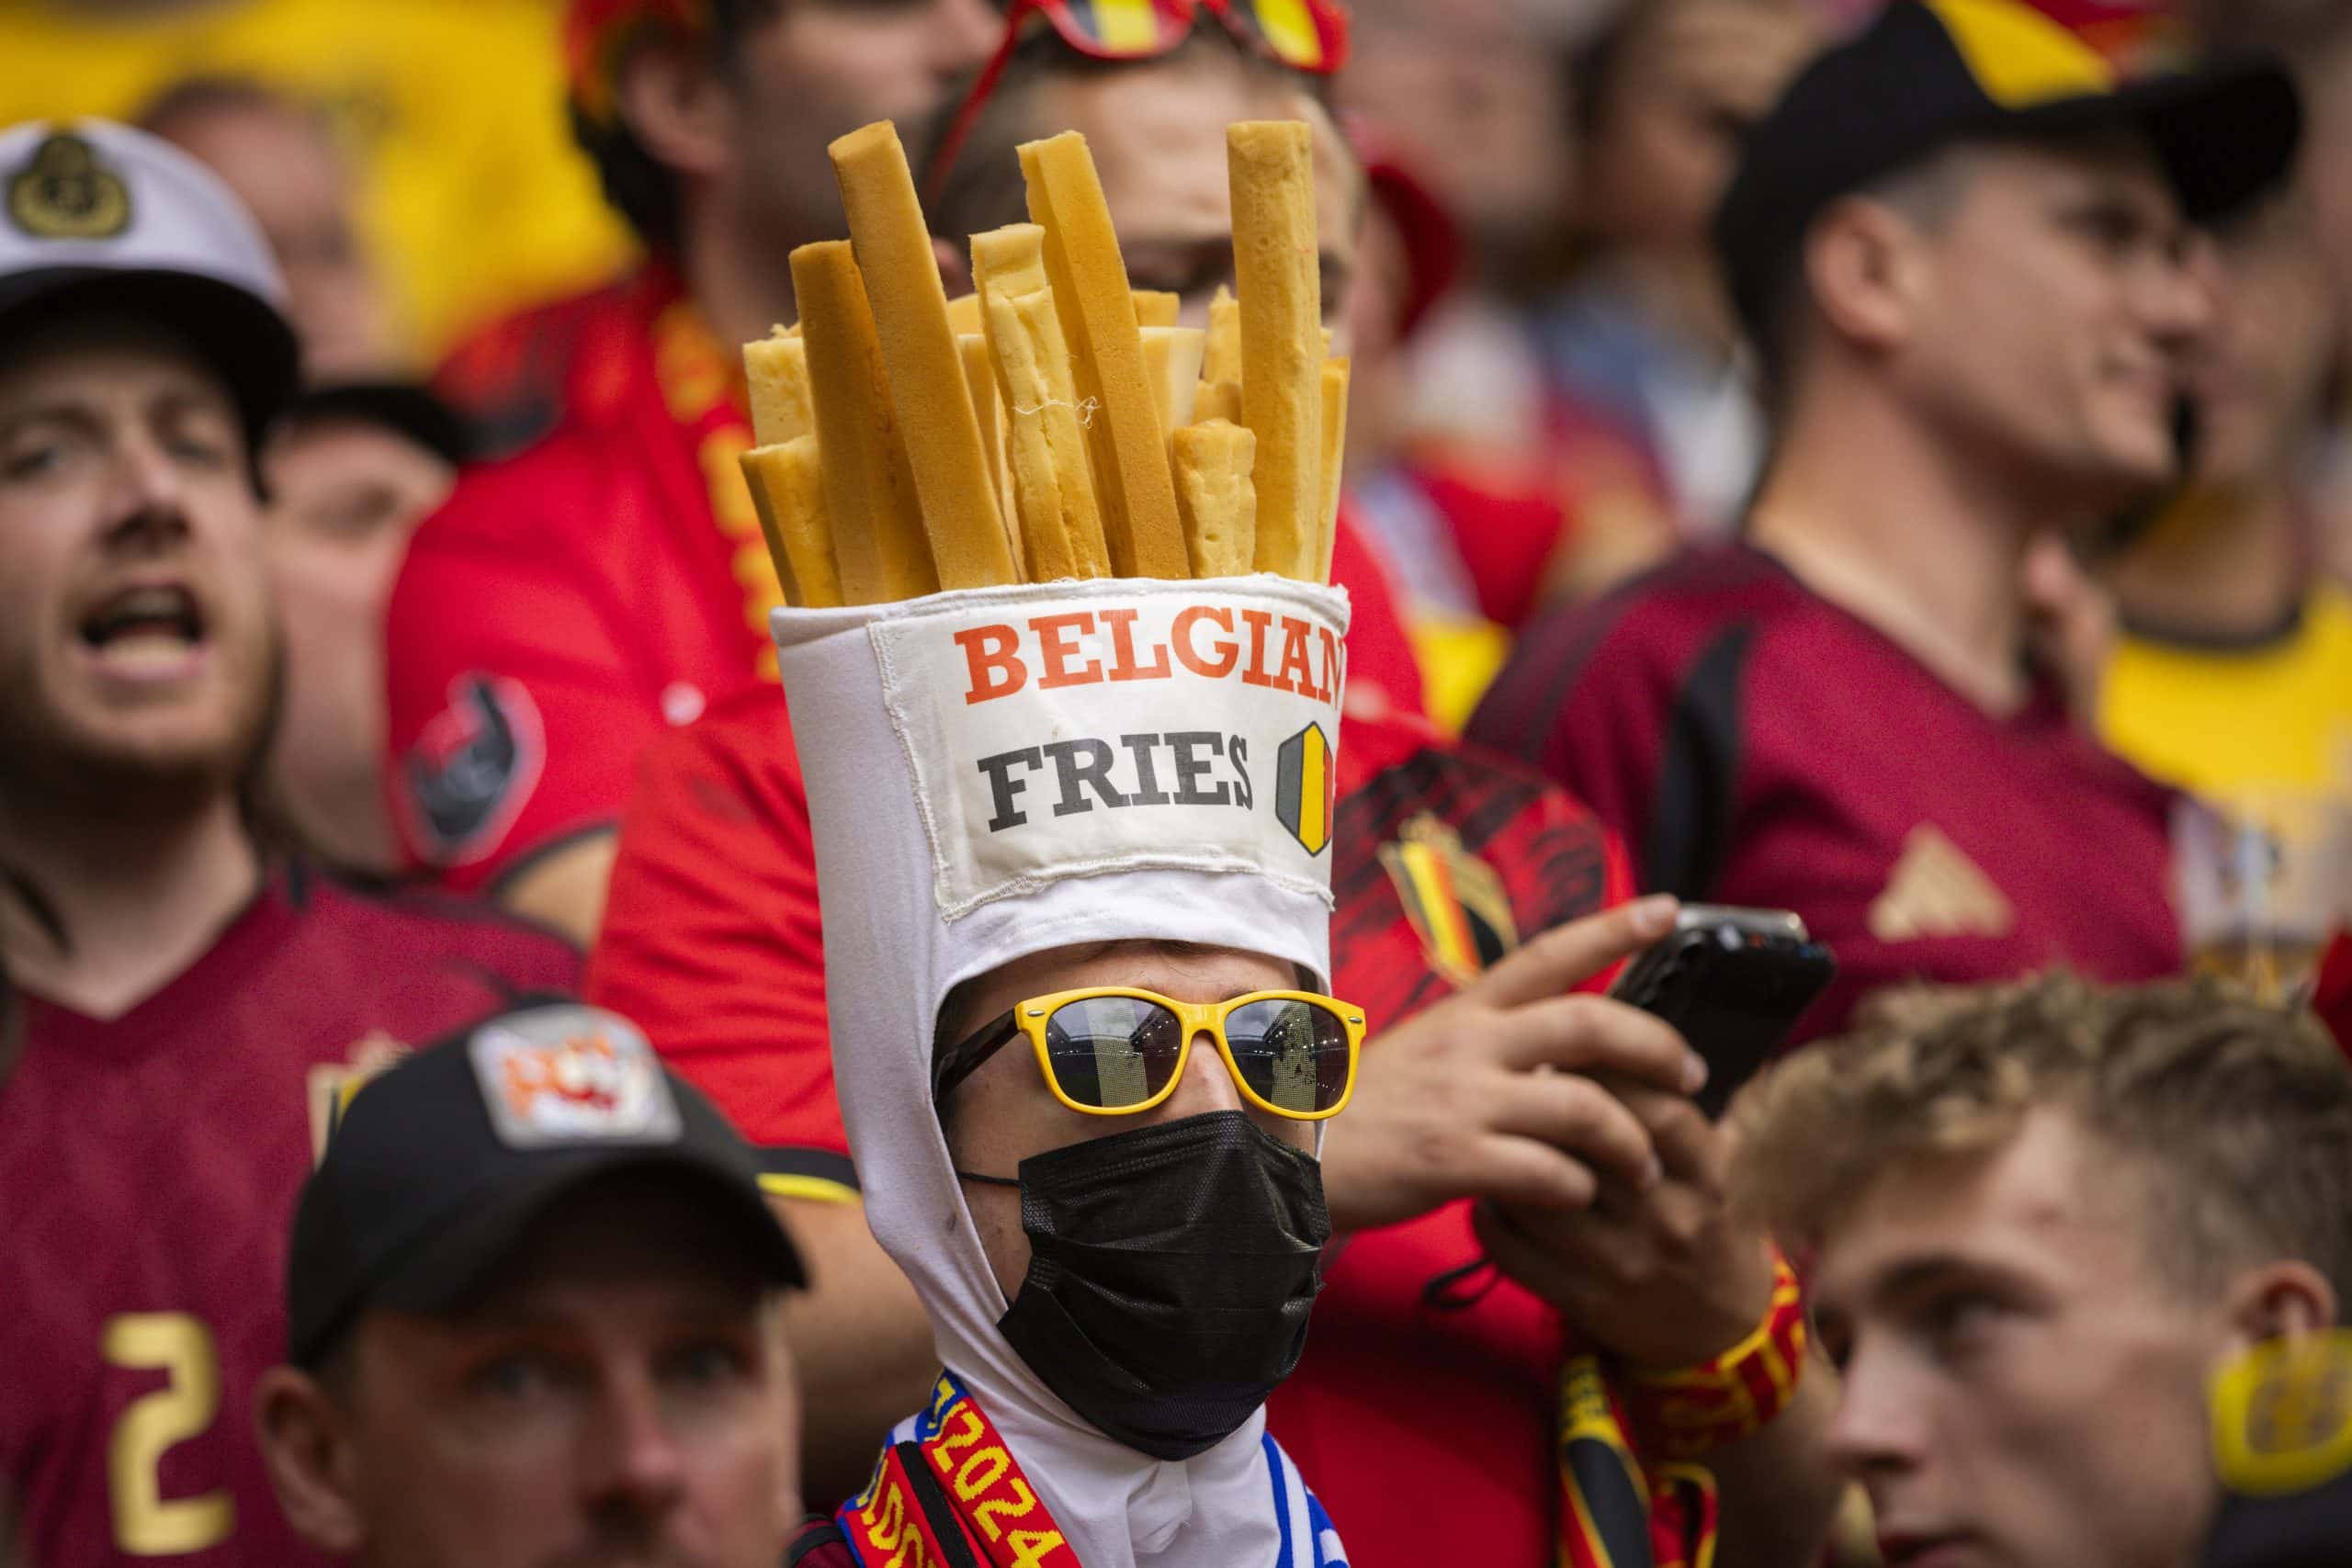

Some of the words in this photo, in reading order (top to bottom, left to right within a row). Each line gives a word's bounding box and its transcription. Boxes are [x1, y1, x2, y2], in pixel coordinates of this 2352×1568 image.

[954, 605, 1343, 710] BELGIAN
[977, 732, 1253, 832] FRIES
[101, 1313, 236, 1555] 2
